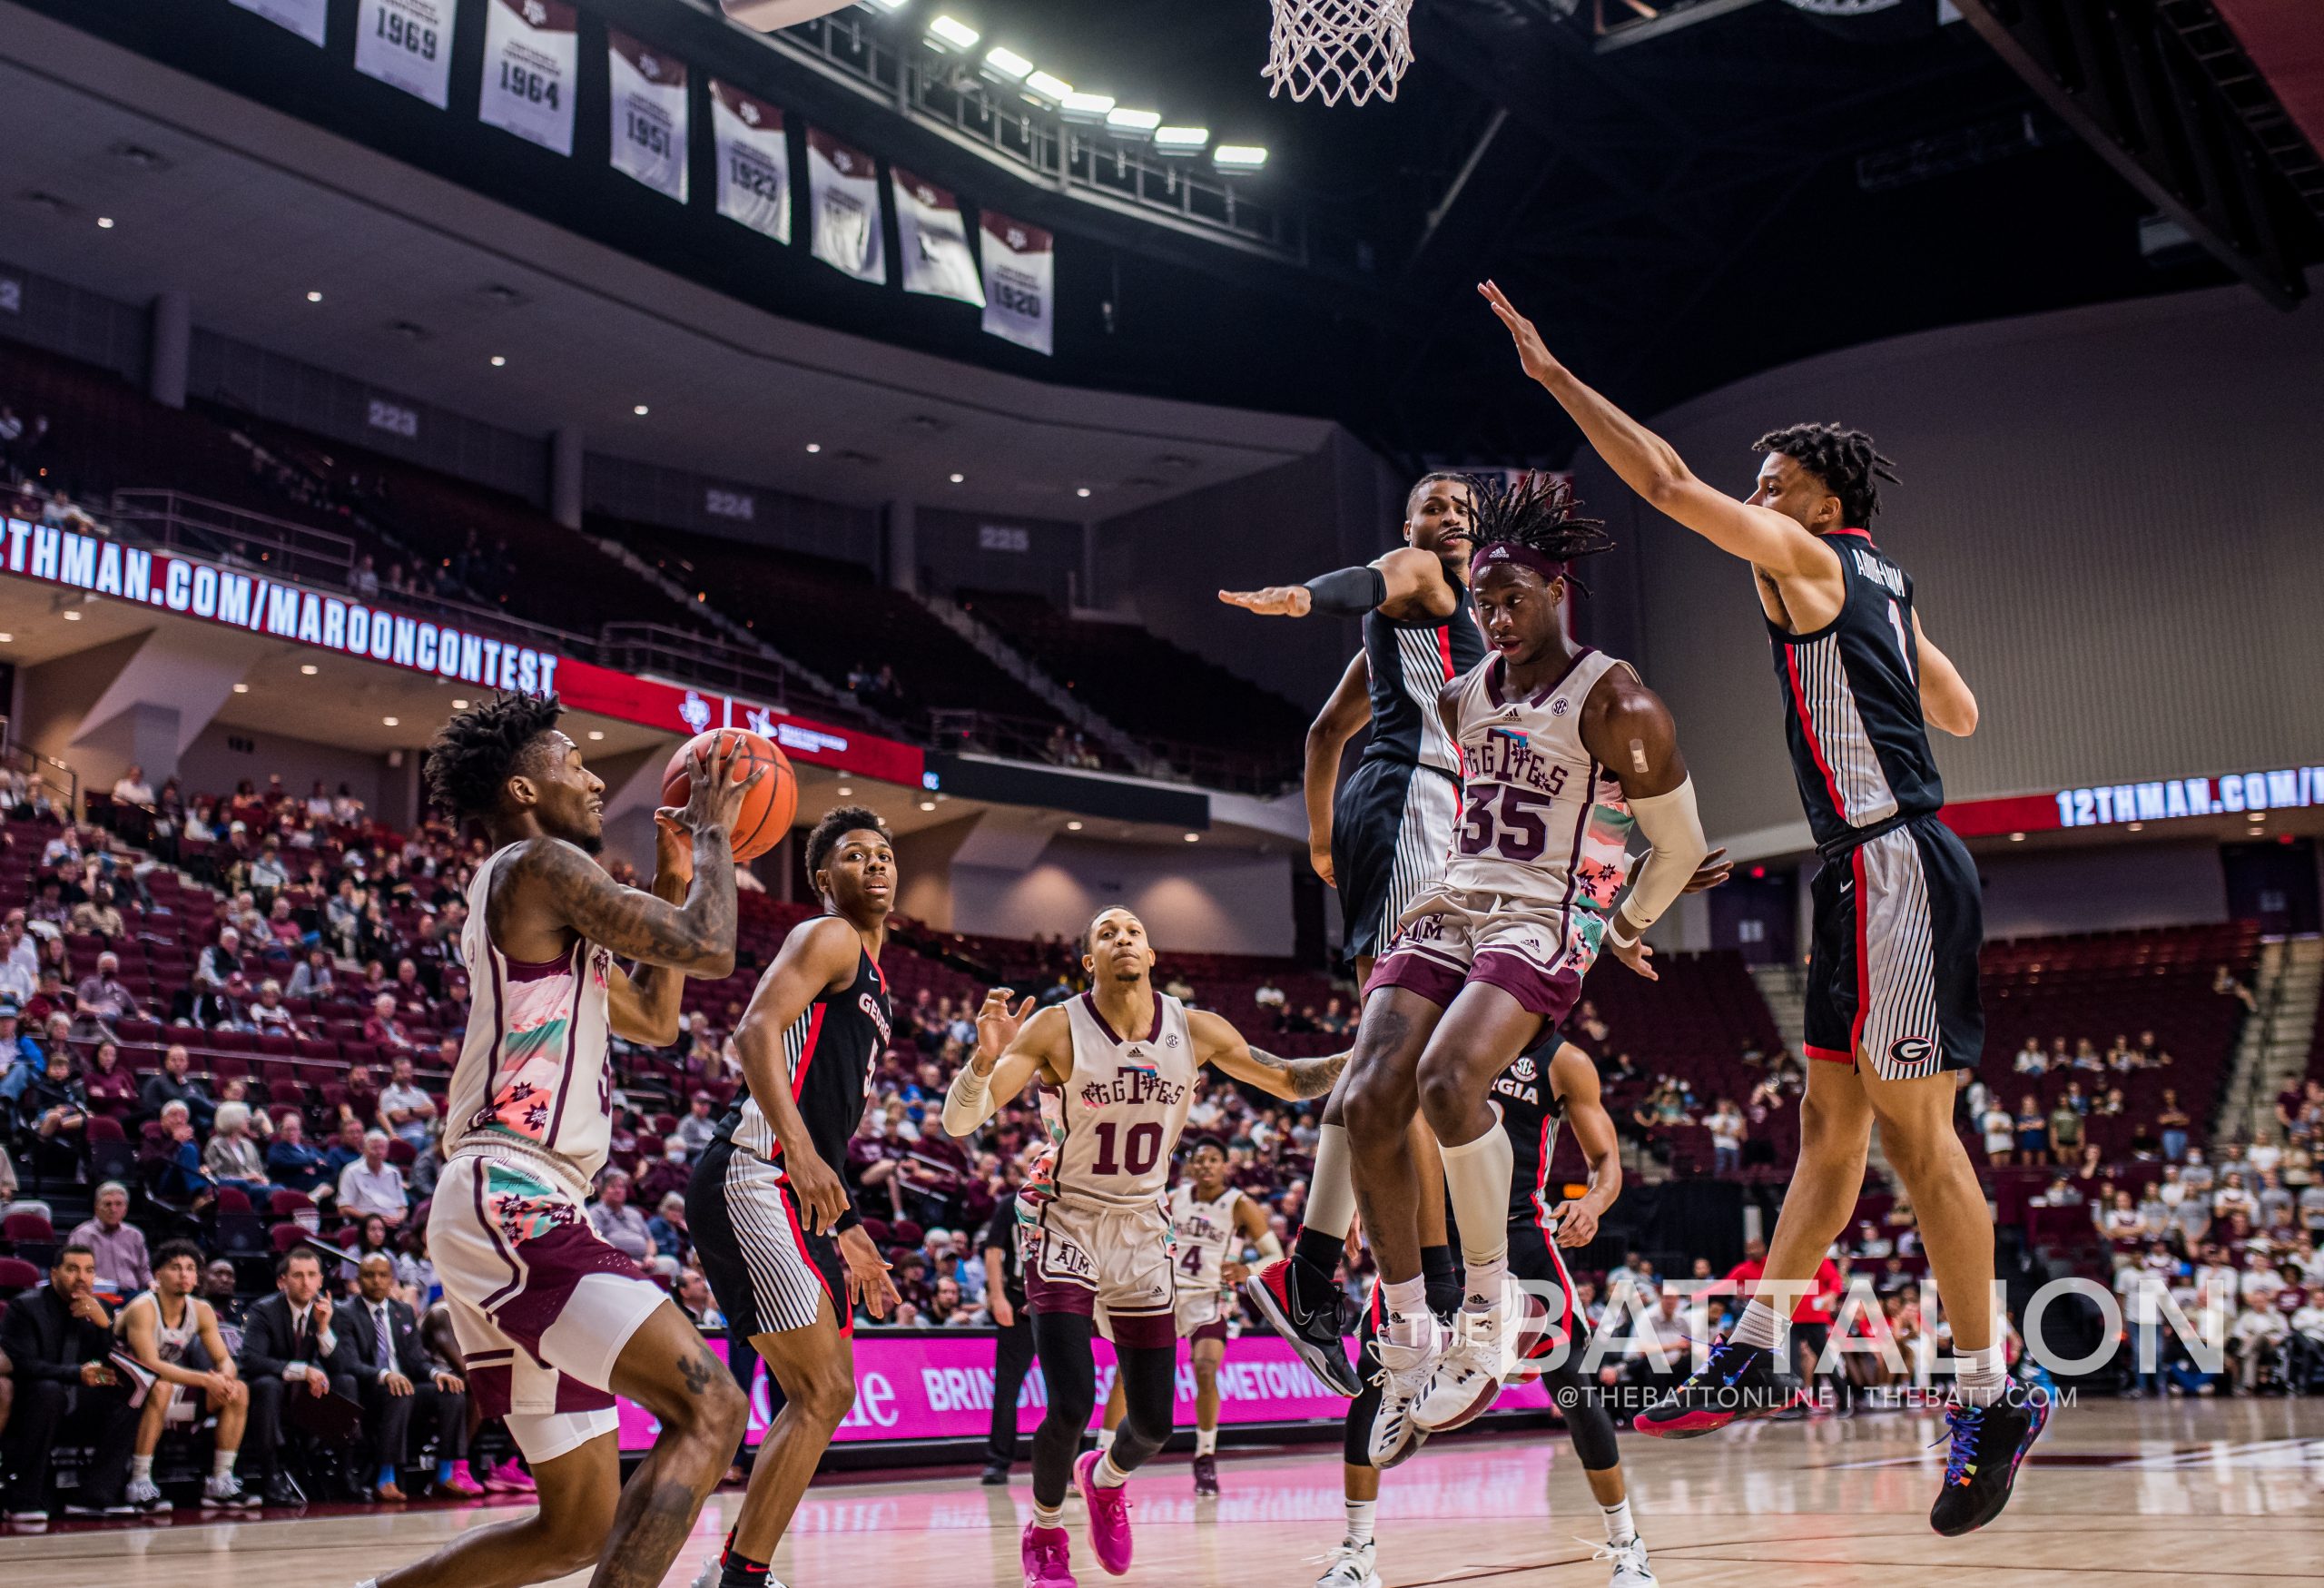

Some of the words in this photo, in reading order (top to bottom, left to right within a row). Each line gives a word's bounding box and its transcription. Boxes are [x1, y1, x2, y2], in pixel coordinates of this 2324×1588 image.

[376, 7, 438, 62] 1969
[500, 61, 559, 111] 1964
[627, 110, 671, 160] 1951
[994, 281, 1039, 319] 1920
[1460, 784, 1551, 862] 35
[1516, 1058, 1535, 1076] SEC
[1092, 1121, 1164, 1176] 10
[1181, 1245, 1202, 1277] 4
